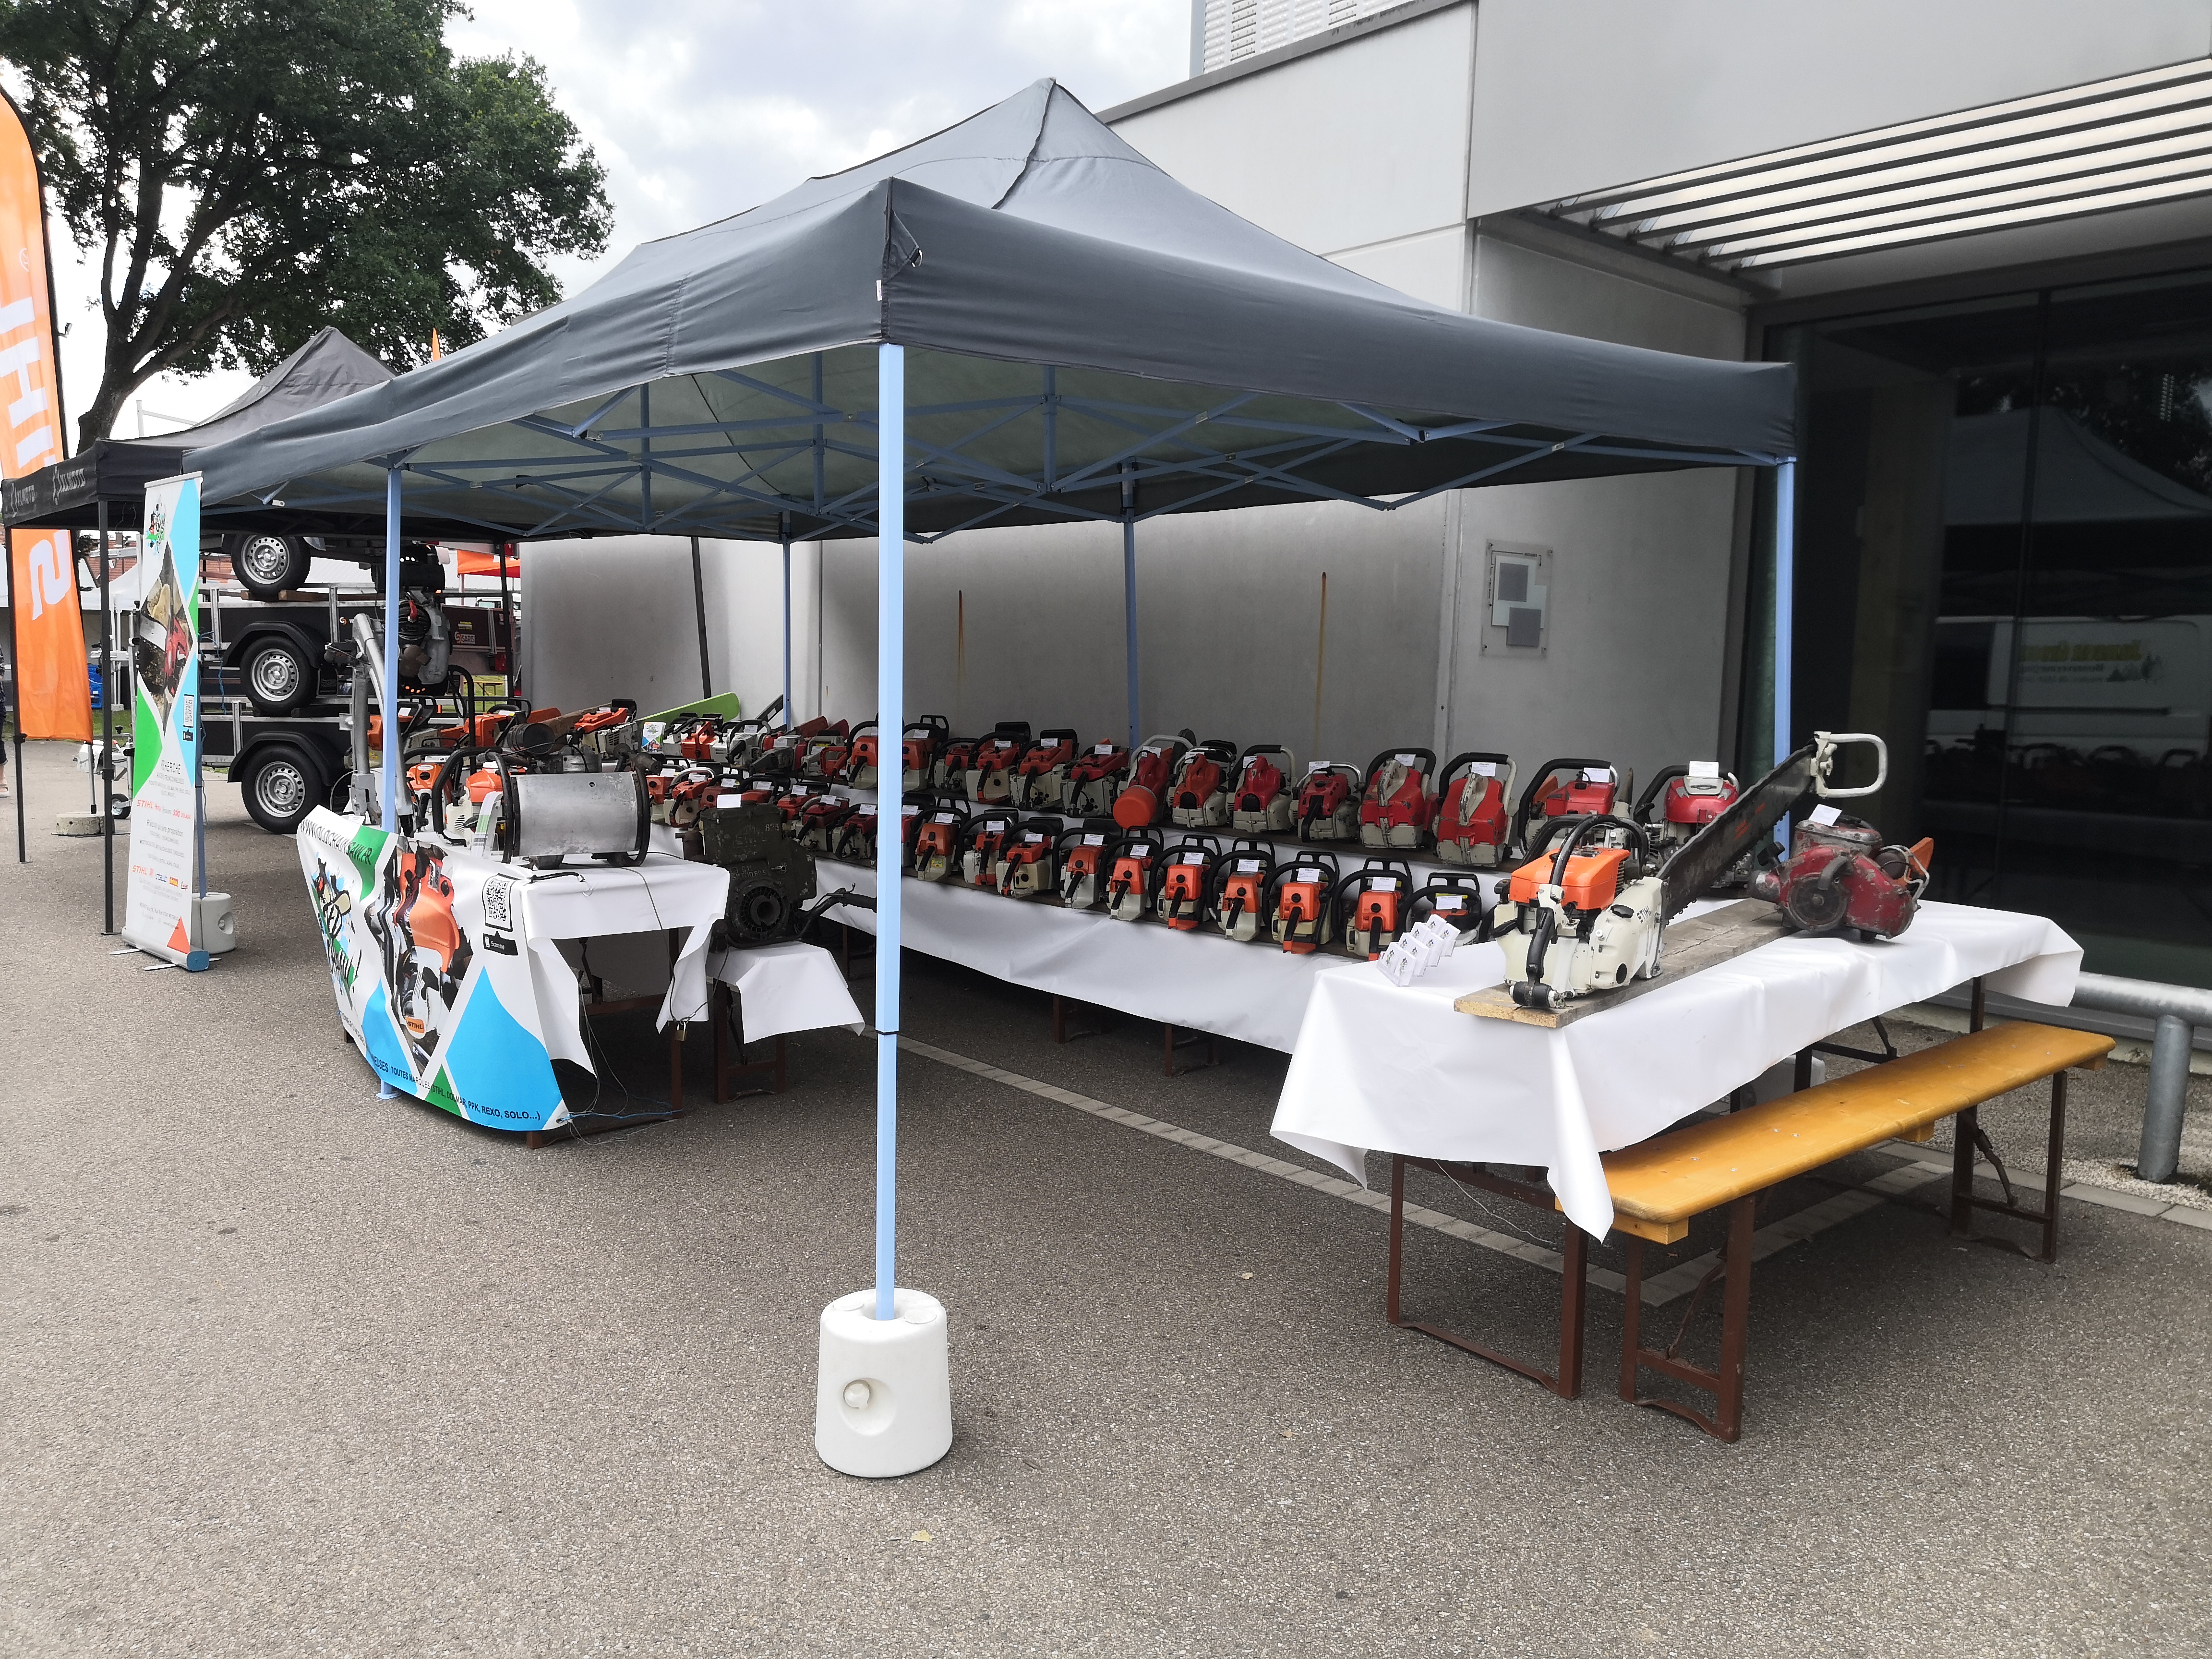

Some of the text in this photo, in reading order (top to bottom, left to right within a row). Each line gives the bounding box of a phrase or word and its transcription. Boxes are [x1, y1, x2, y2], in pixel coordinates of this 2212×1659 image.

[137, 799, 153, 809] STIHL
[132, 865, 147, 875] STIHL
[1636, 905, 1652, 924] STIHL
[408, 1021, 423, 1030] STIHL
[391, 1066, 409, 1080] TOUTES
[409, 1073, 430, 1089] MARQUES
[468, 1100, 481, 1113] PPK,
[481, 1106, 503, 1119] REXO,
[504, 1110, 541, 1121] SOLO...)
